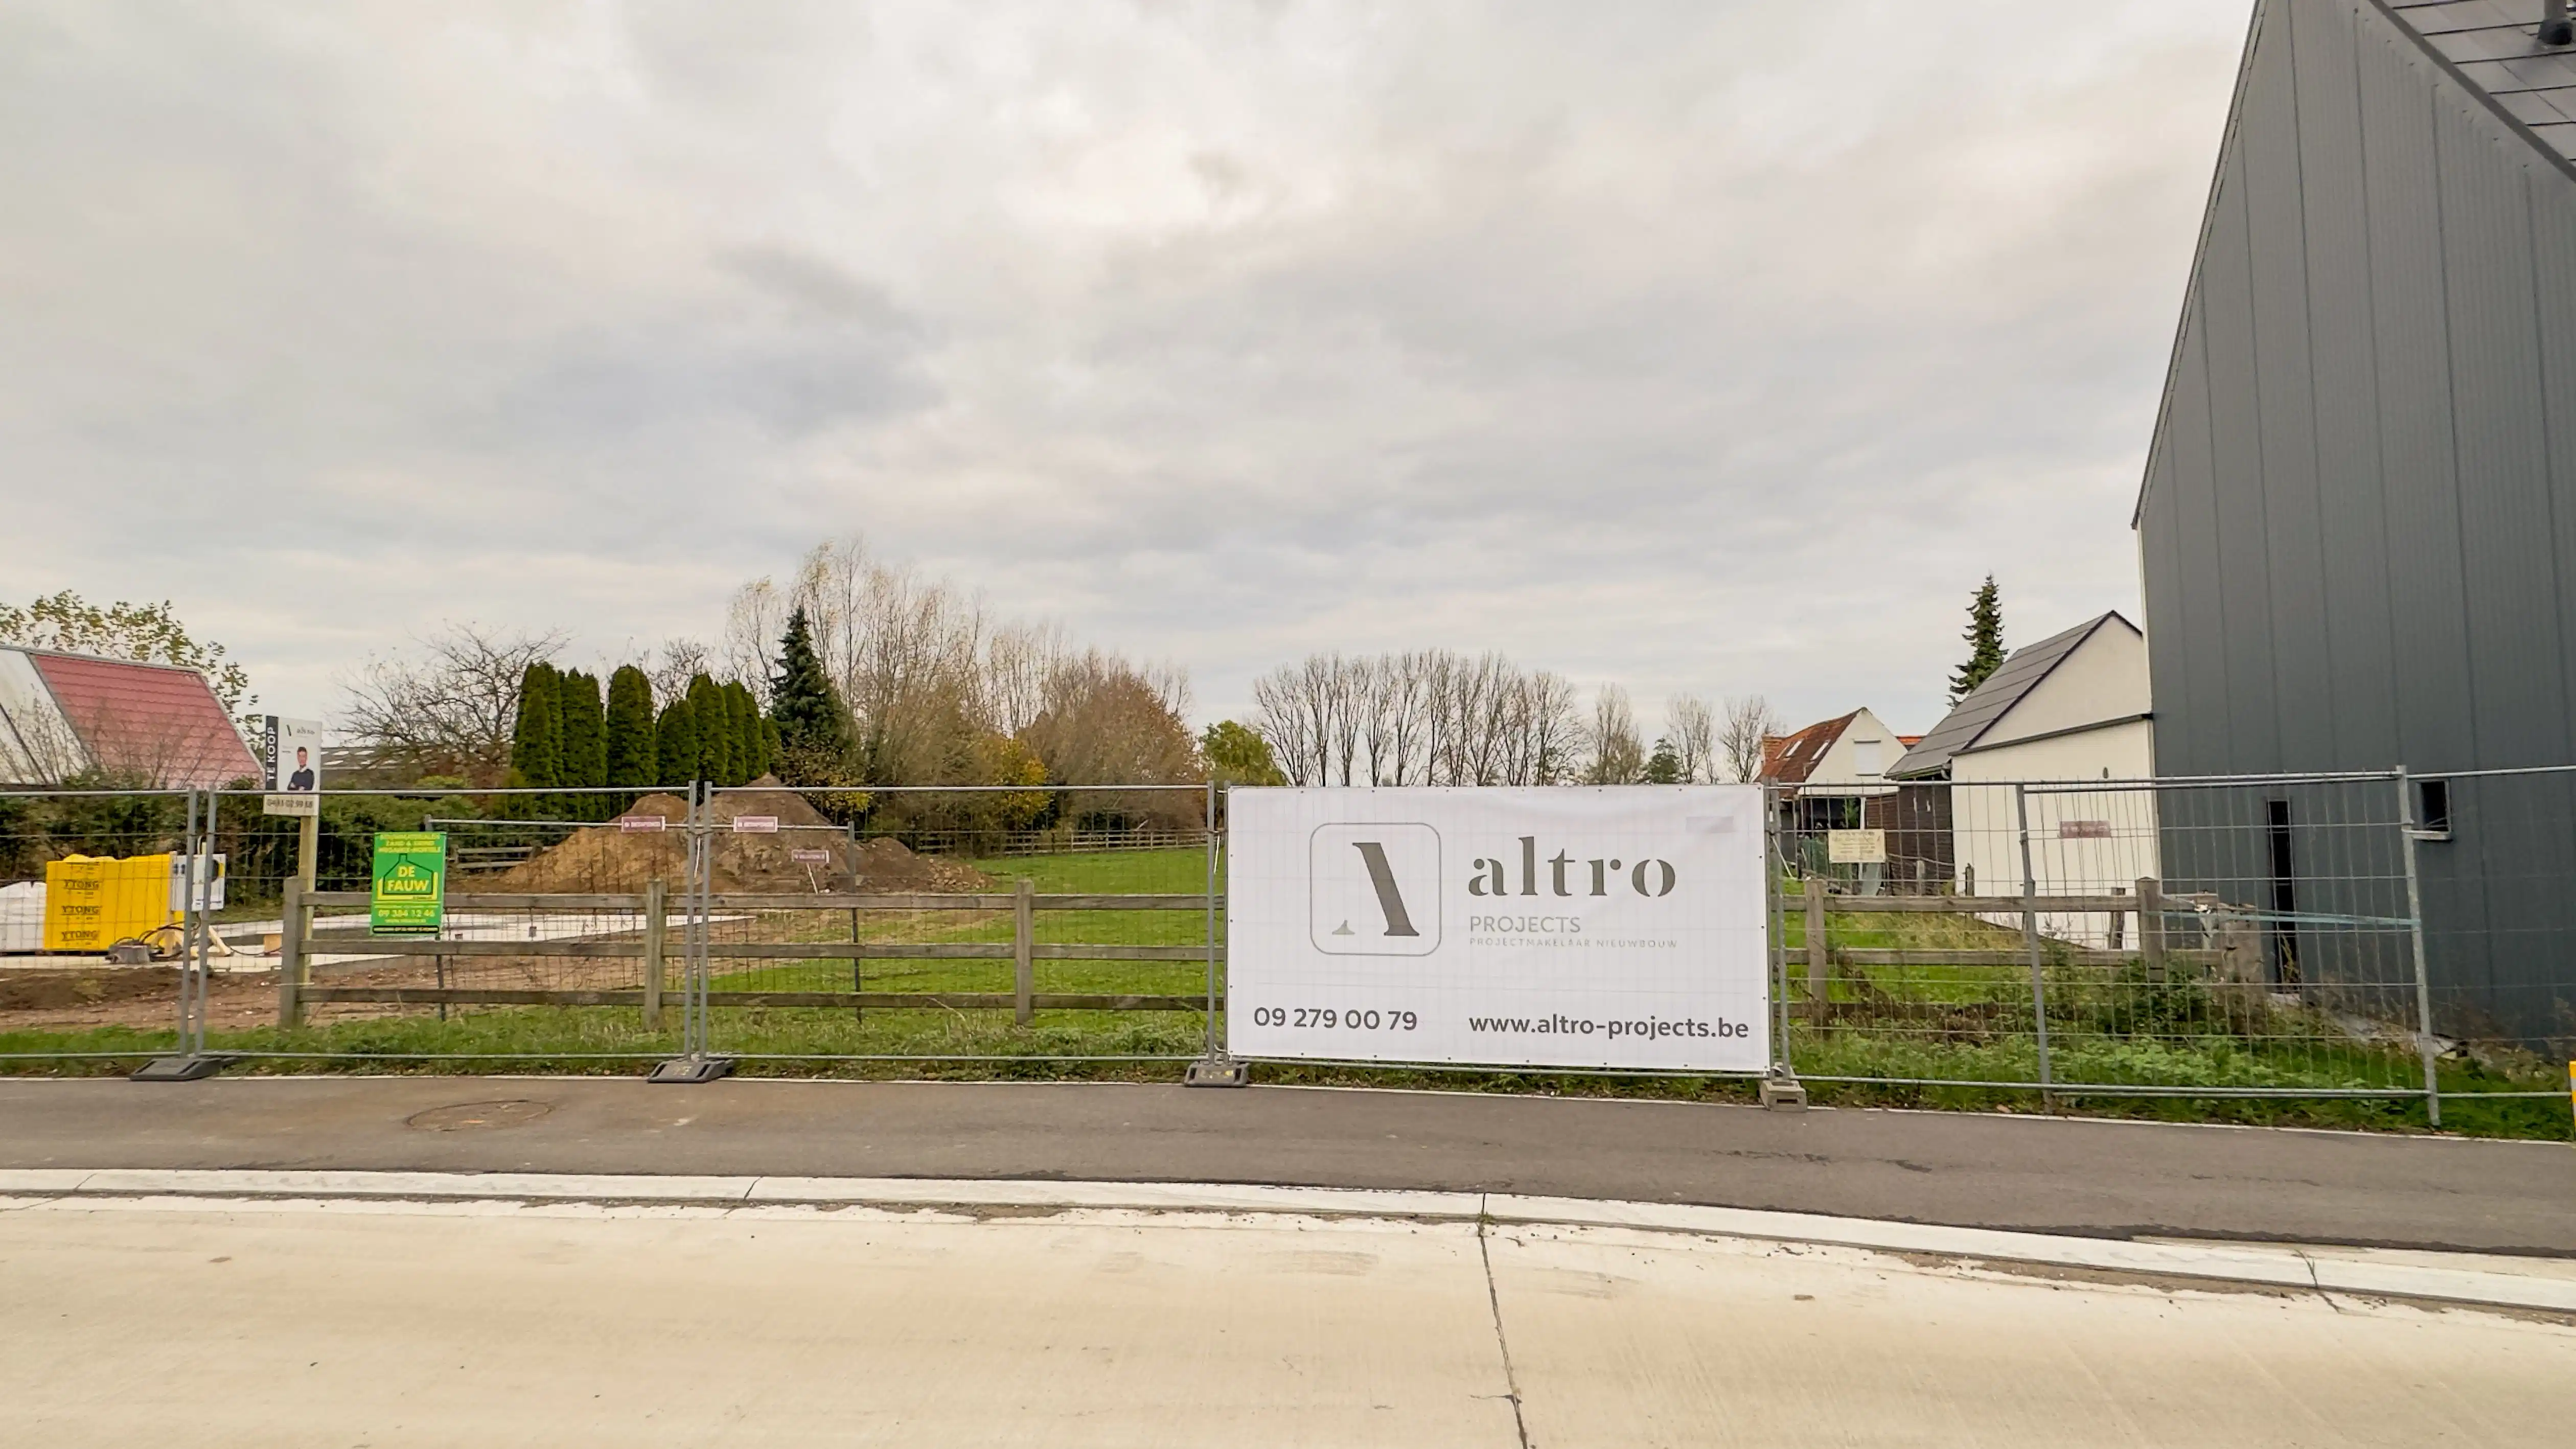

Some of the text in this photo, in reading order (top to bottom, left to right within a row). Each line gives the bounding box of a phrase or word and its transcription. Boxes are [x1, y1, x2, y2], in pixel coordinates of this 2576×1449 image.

[267, 726, 277, 780] TE KOOP
[398, 865, 416, 878] DE
[1468, 836, 1676, 898] altro
[63, 879, 99, 890] YTONG
[387, 879, 429, 892] FAUW
[61, 905, 100, 915] YTONG
[1470, 915, 1581, 933] PROJECTS
[61, 931, 99, 941] YTONG
[1469, 937, 1677, 948] PROJECTMAKELAAR NIEUWBOUW
[1254, 1006, 1417, 1031] 09 279 00 79
[1468, 1013, 1749, 1040] www.altro-projects.be
